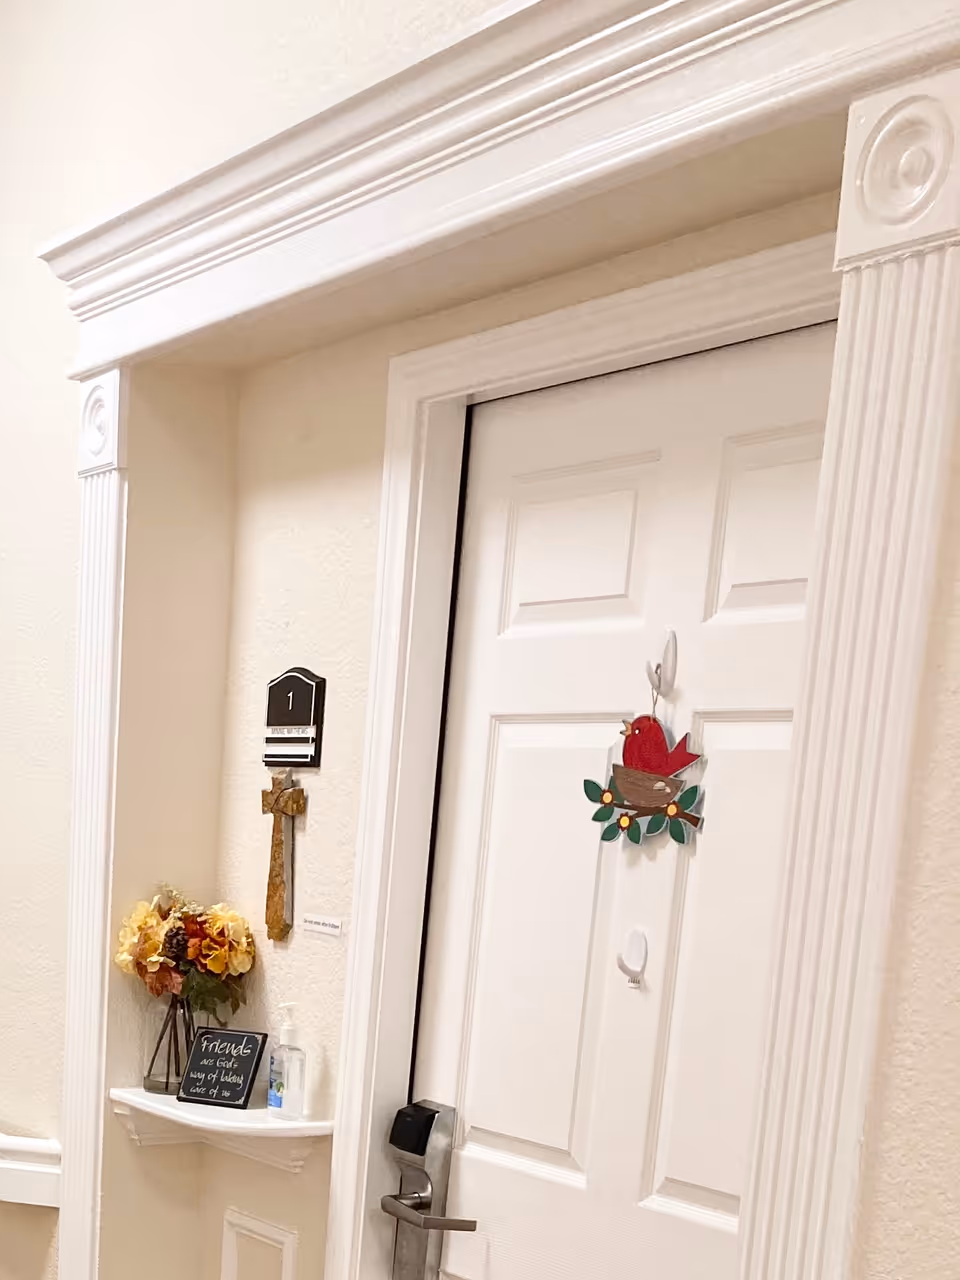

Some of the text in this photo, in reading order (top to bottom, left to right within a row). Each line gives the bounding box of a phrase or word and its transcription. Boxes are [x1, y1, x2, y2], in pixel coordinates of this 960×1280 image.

[287, 691, 293, 710] 1
[201, 1035, 252, 1056] Friends
[200, 1058, 214, 1066] are
[190, 1071, 205, 1086] way
[208, 1069, 219, 1084] of
[190, 1086, 206, 1094] care
[209, 1085, 219, 1098] of
